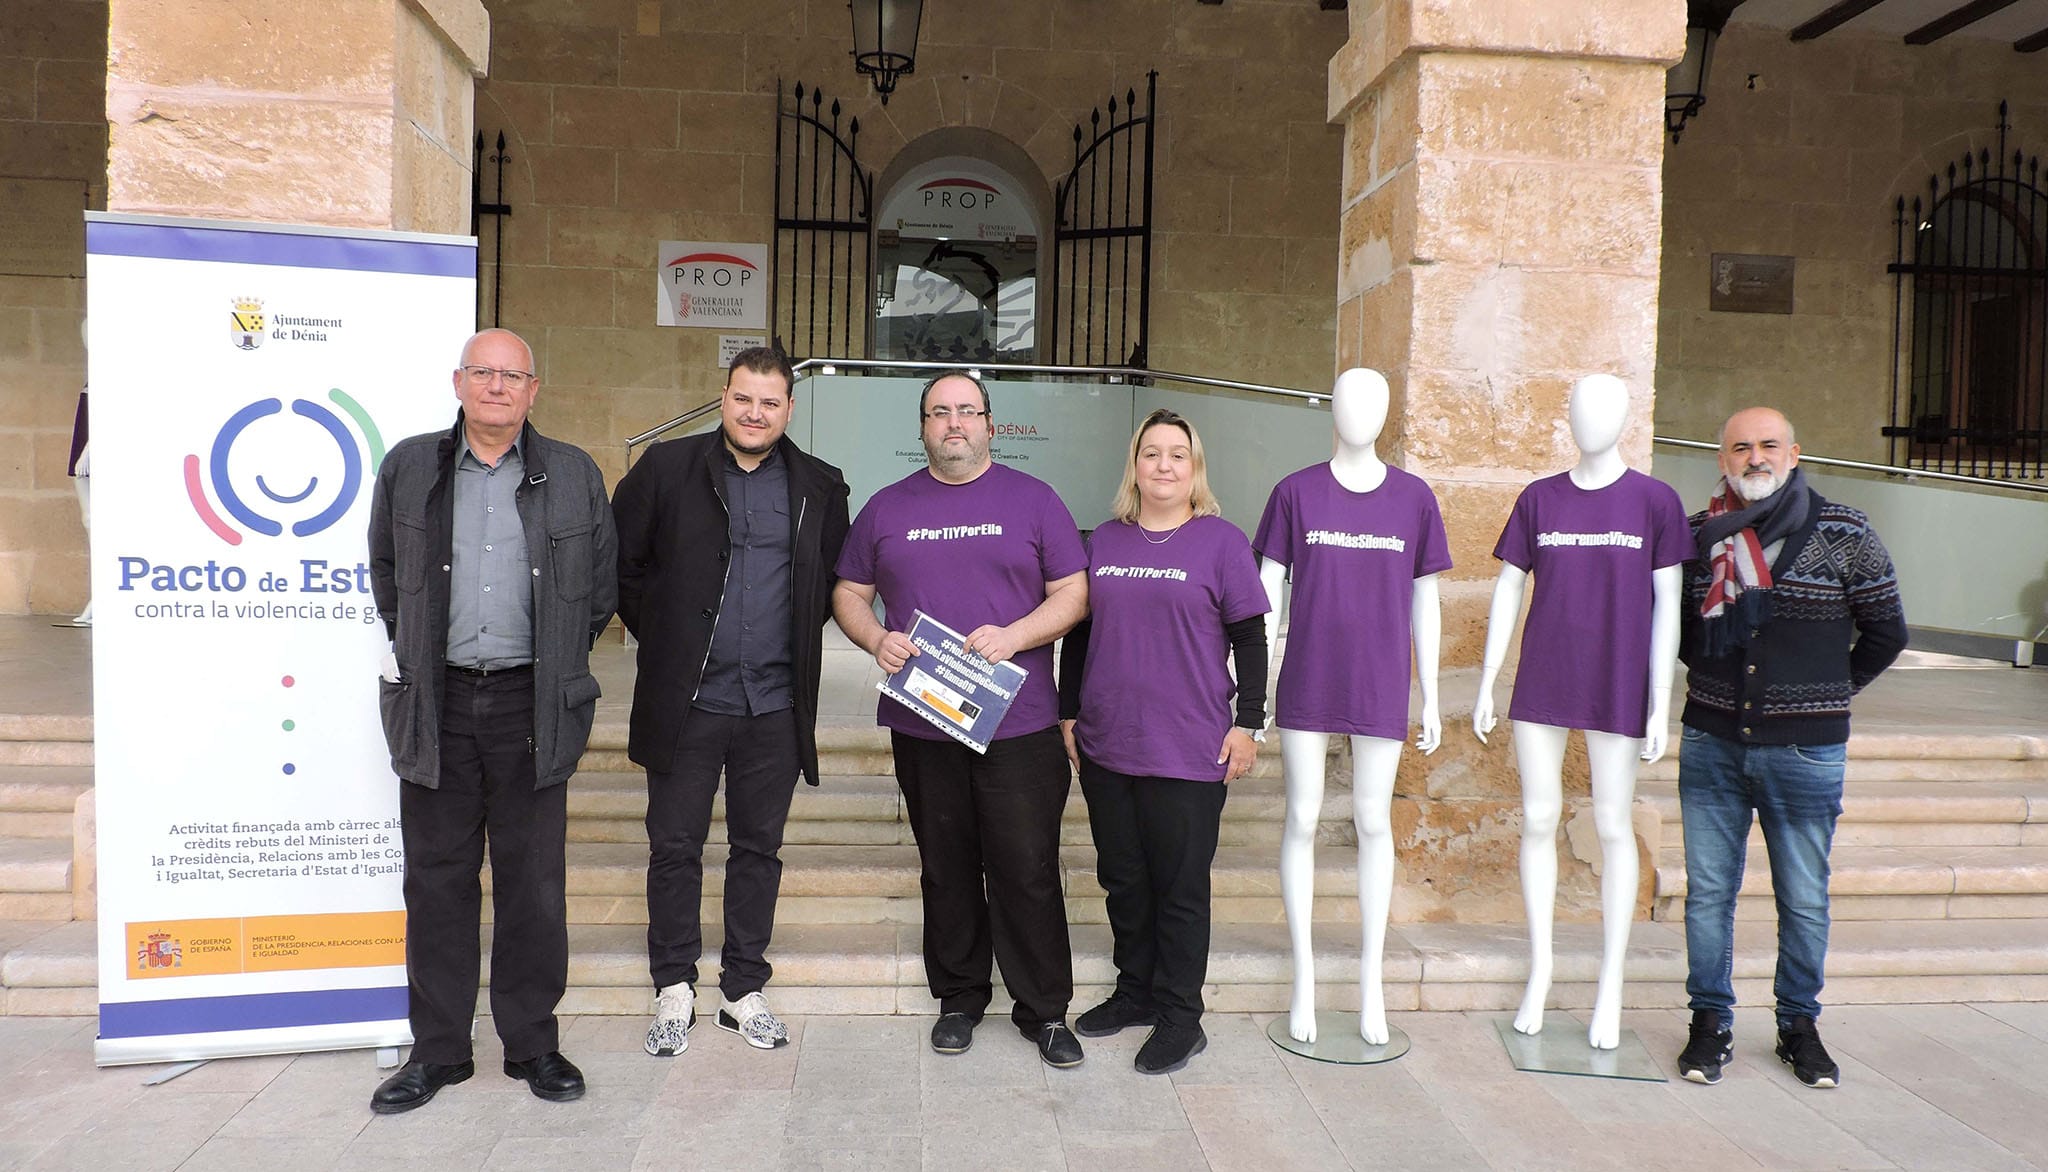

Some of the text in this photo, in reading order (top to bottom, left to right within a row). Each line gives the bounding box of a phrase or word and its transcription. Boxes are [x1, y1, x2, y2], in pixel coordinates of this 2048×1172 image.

[924, 190, 995, 209] PROP
[675, 267, 751, 286] PROP
[692, 296, 743, 307] GENERALITAT
[692, 307, 743, 317] VALENCIANA
[272, 314, 342, 328] Ajuntament
[272, 328, 327, 342] de Dénia
[997, 423, 1037, 435] DÉNIA
[118, 556, 247, 592] Pacto
[258, 572, 288, 593] de
[135, 602, 204, 618] contra
[212, 600, 229, 618] la
[235, 601, 326, 619] violencia
[332, 602, 356, 619] de
[169, 822, 229, 835] Activitat
[232, 820, 300, 834] finançada
[305, 820, 335, 831] amb
[339, 819, 380, 830] càrrec
[184, 833, 389, 849] crèdits rebuts del Ministeri de
[152, 856, 165, 866] la
[170, 852, 254, 865] Presidència,
[259, 850, 323, 862] Relacions
[328, 849, 357, 860] amb
[361, 849, 380, 859] les
[156, 870, 161, 881] i
[166, 869, 224, 884] Igualtat,
[228, 866, 297, 879] Secretaria
[301, 865, 348, 876] d'Estat
[190, 938, 232, 946] GOBIERNO
[328, 939, 373, 947] RELACIONES
